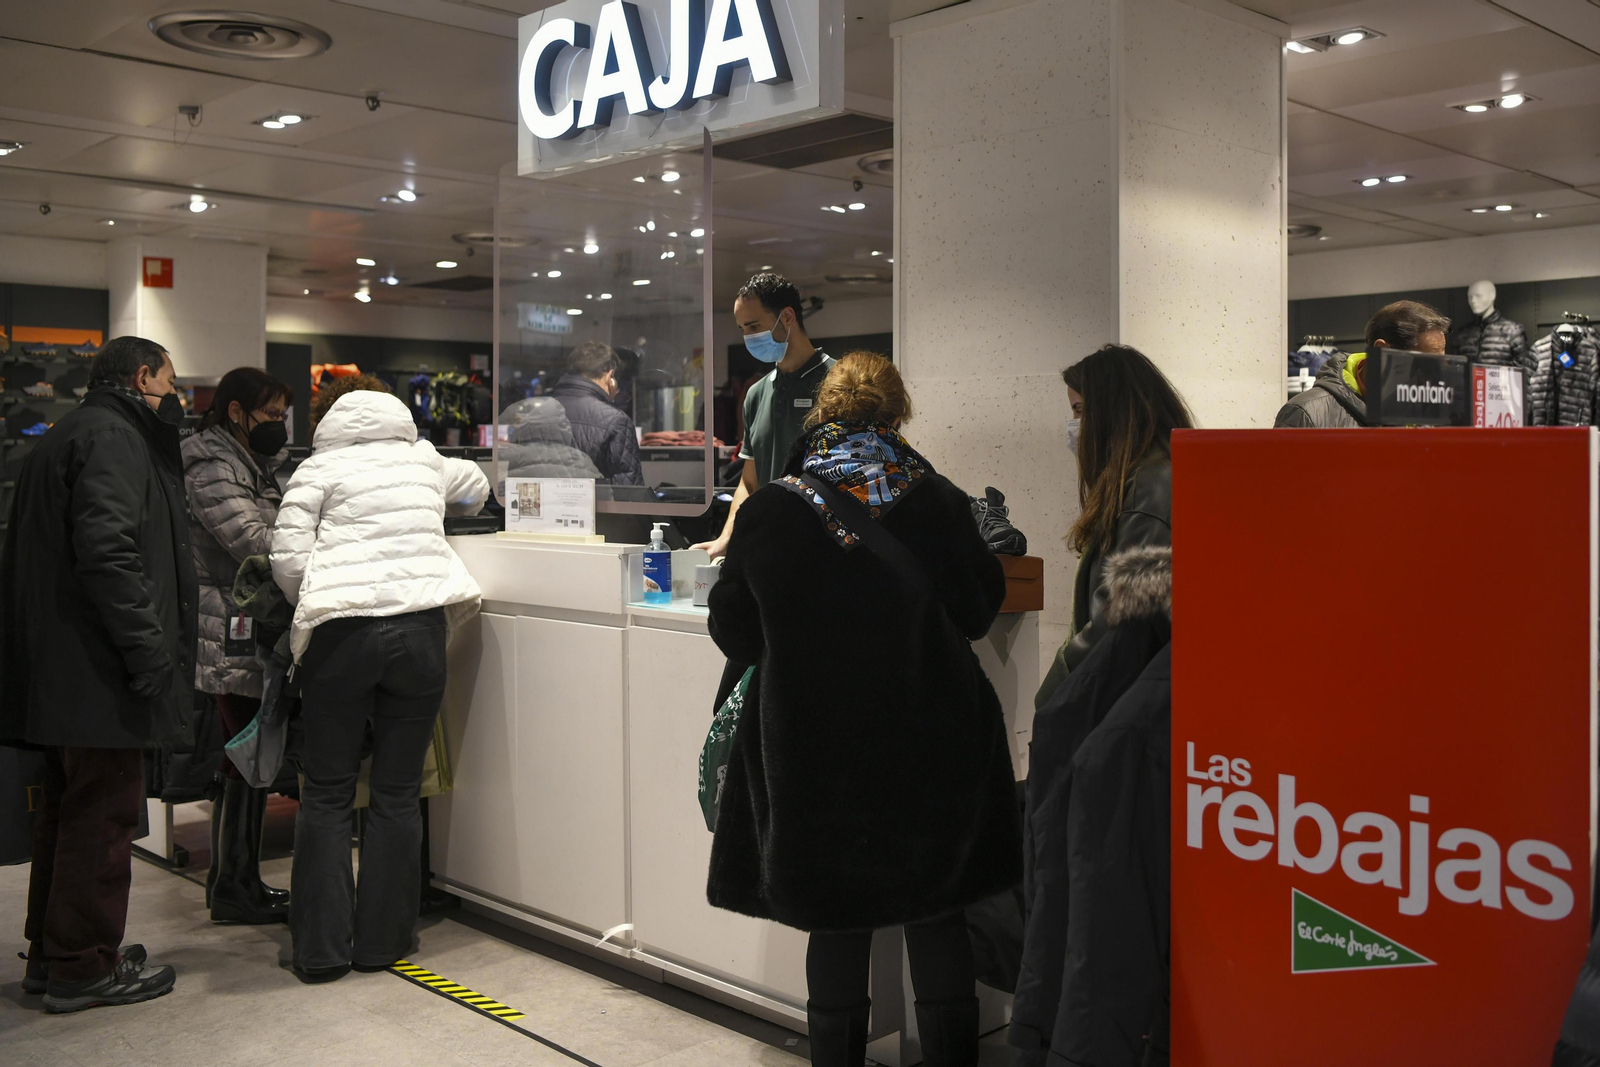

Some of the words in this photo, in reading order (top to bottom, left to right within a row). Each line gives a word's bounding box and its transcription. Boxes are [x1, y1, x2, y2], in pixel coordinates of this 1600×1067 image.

[518, 0, 779, 139] CAJA
[1396, 381, 1454, 404] montaña
[1187, 741, 1252, 786] Las
[1187, 773, 1575, 921] rebajas
[1297, 921, 1312, 940] El
[1312, 926, 1346, 948] Corte
[1347, 929, 1399, 961] Inglés
